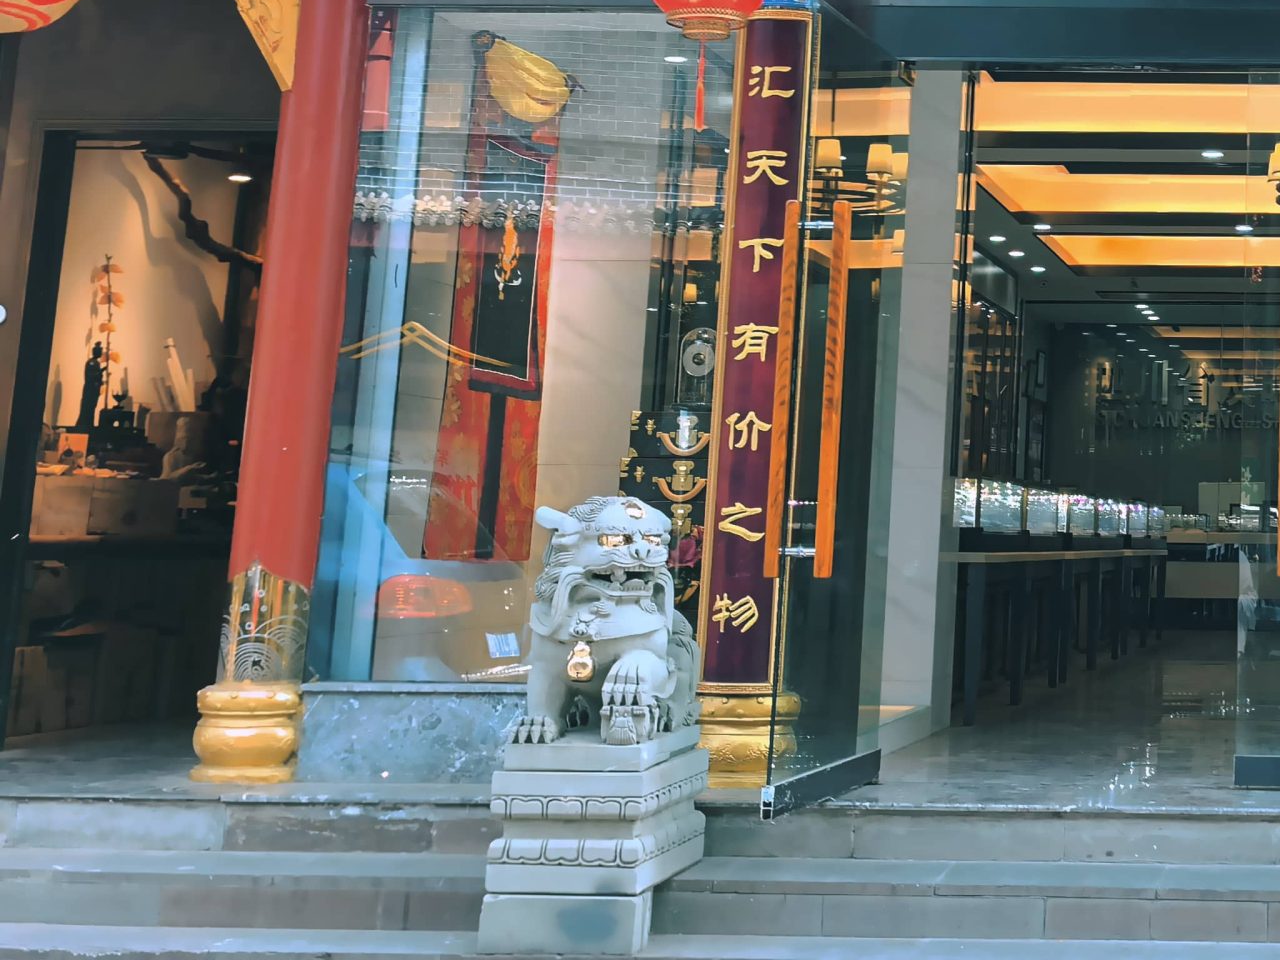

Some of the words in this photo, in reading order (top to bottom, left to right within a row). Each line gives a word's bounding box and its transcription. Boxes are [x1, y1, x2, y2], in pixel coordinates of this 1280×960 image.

[711, 64, 796, 634] 汇天下有价之物
